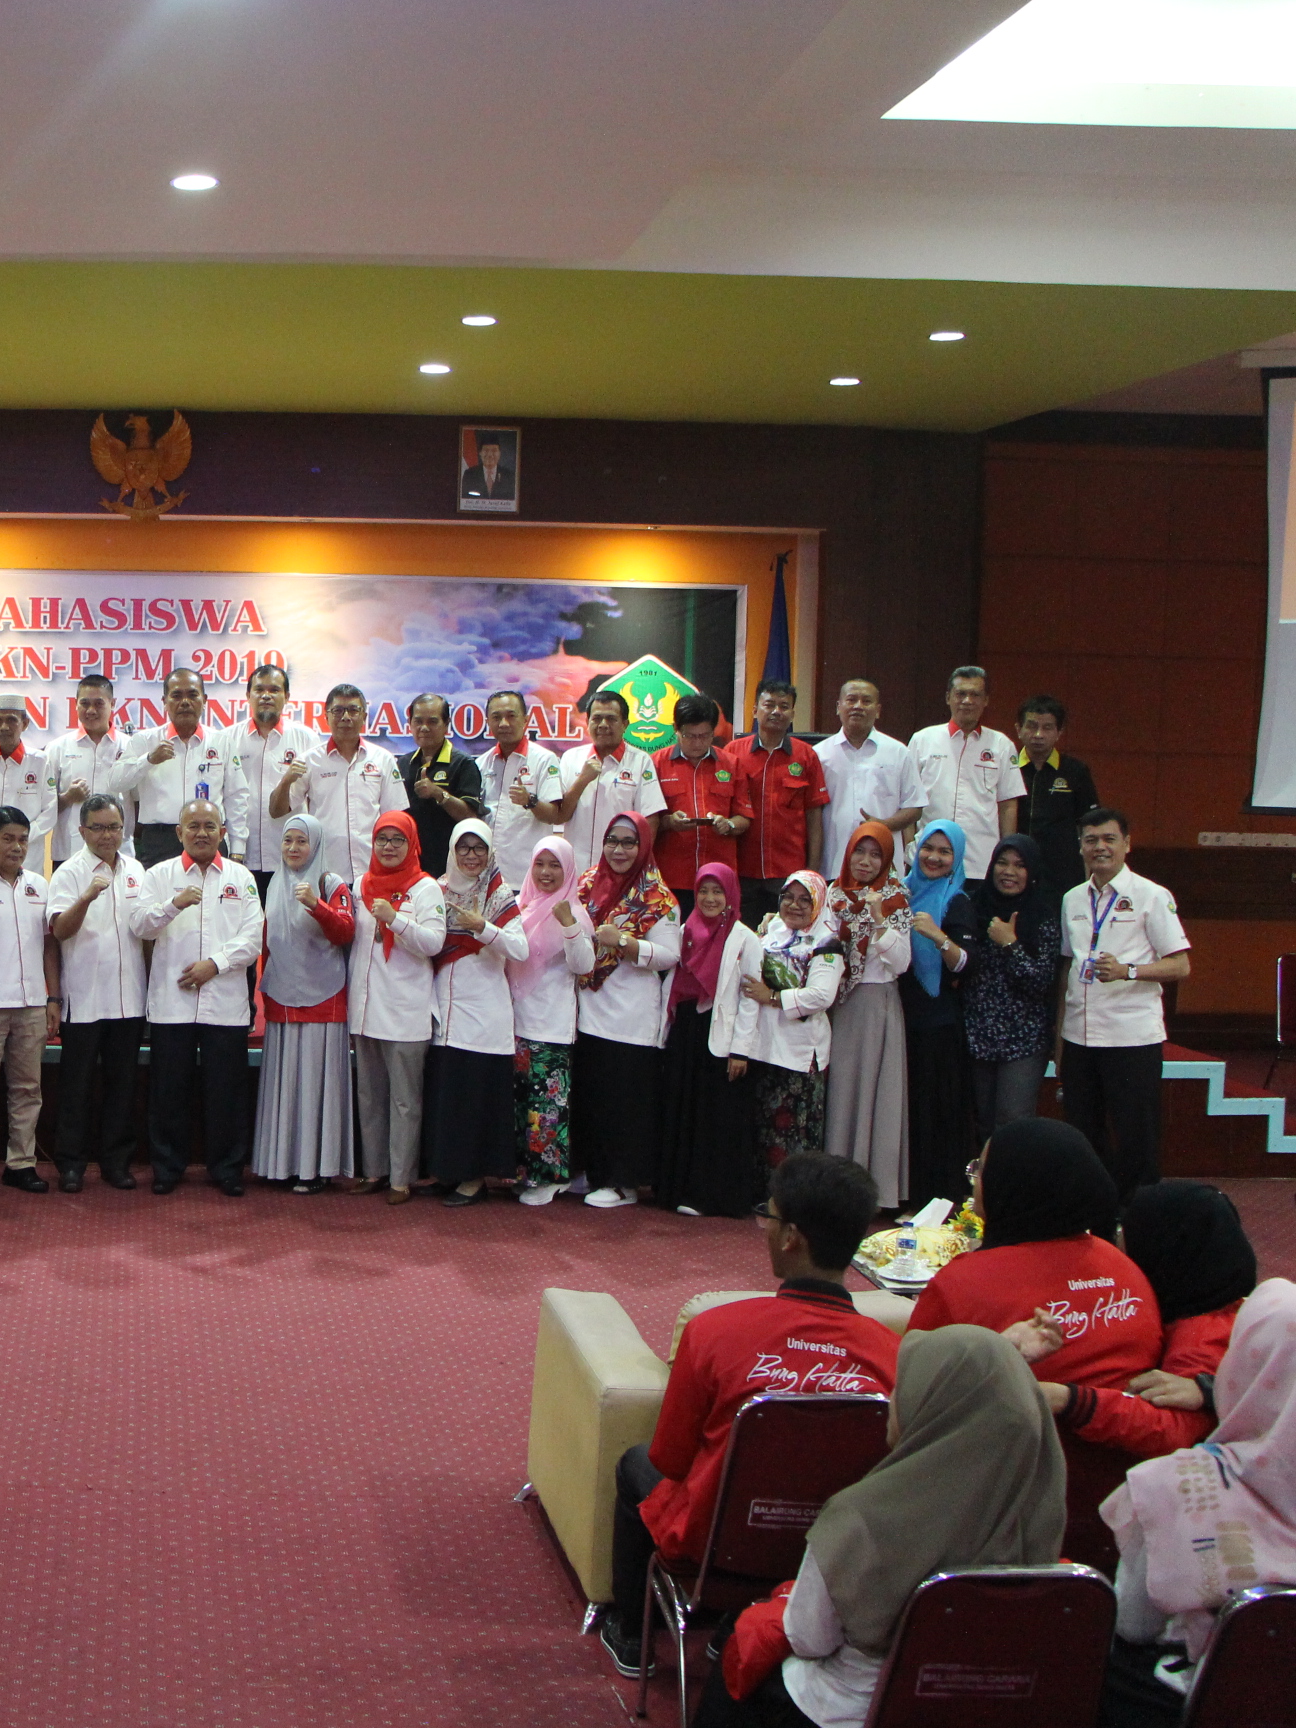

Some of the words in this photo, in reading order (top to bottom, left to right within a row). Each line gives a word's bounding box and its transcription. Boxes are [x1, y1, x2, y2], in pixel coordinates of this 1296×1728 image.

[1067, 1277, 1115, 1291] Universitas
[787, 1337, 847, 1357] Universitas
[746, 1352, 799, 1392] Bung
